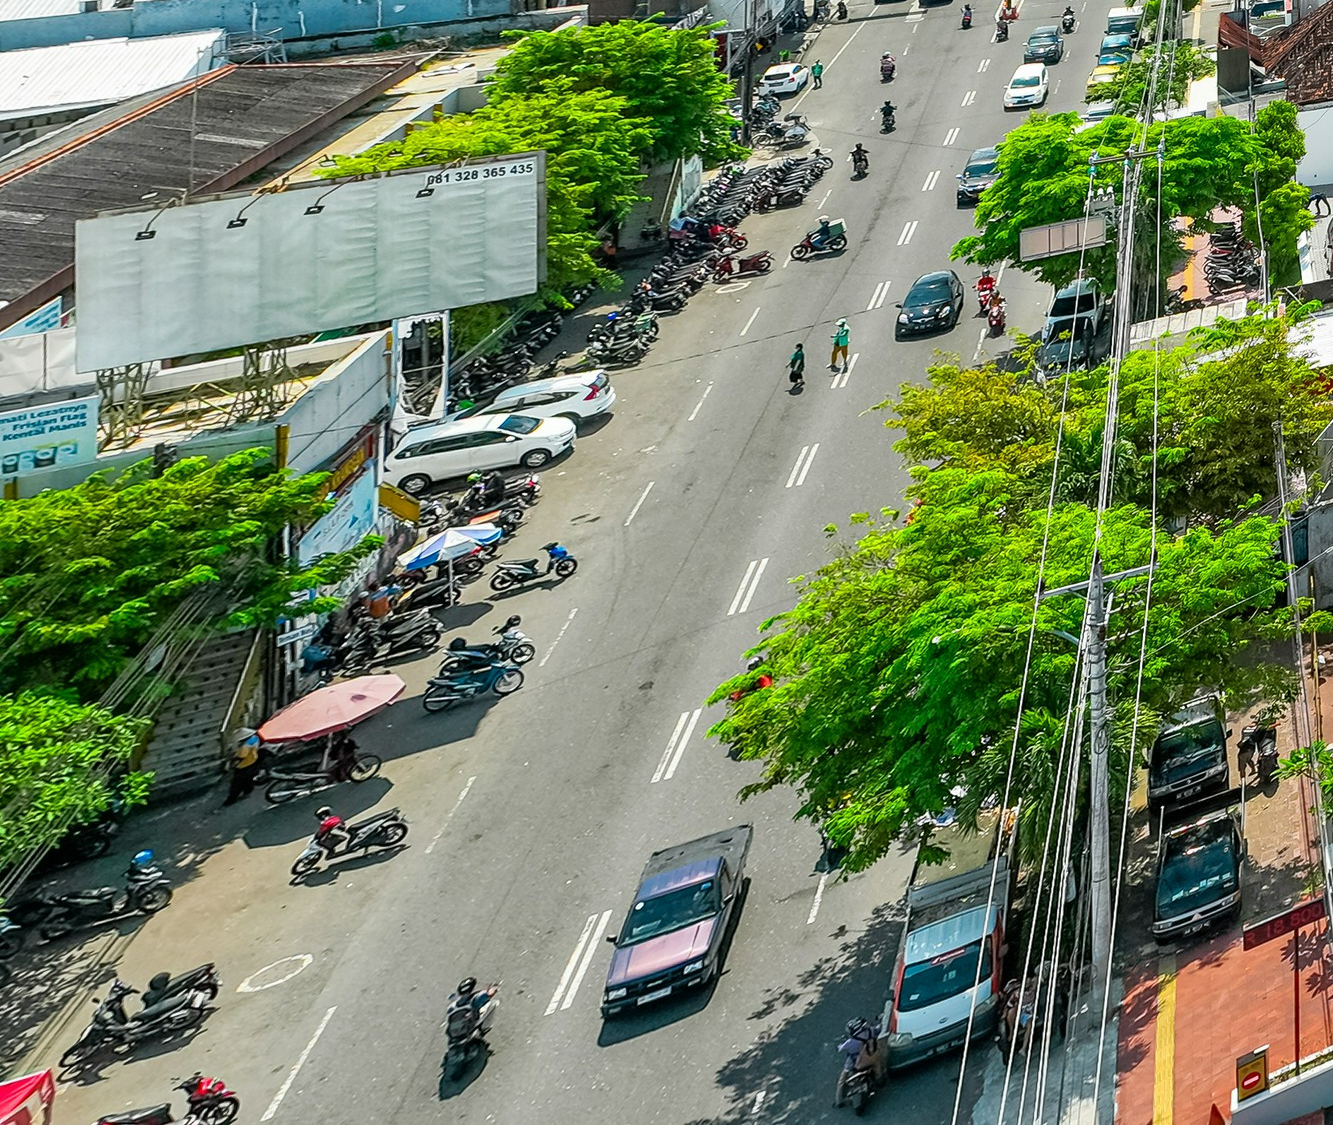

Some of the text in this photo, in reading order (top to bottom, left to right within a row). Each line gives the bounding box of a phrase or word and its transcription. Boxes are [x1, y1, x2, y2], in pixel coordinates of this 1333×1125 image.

[428, 163, 533, 185] 081 328 365 435
[3, 421, 87, 441] Kental Manis
